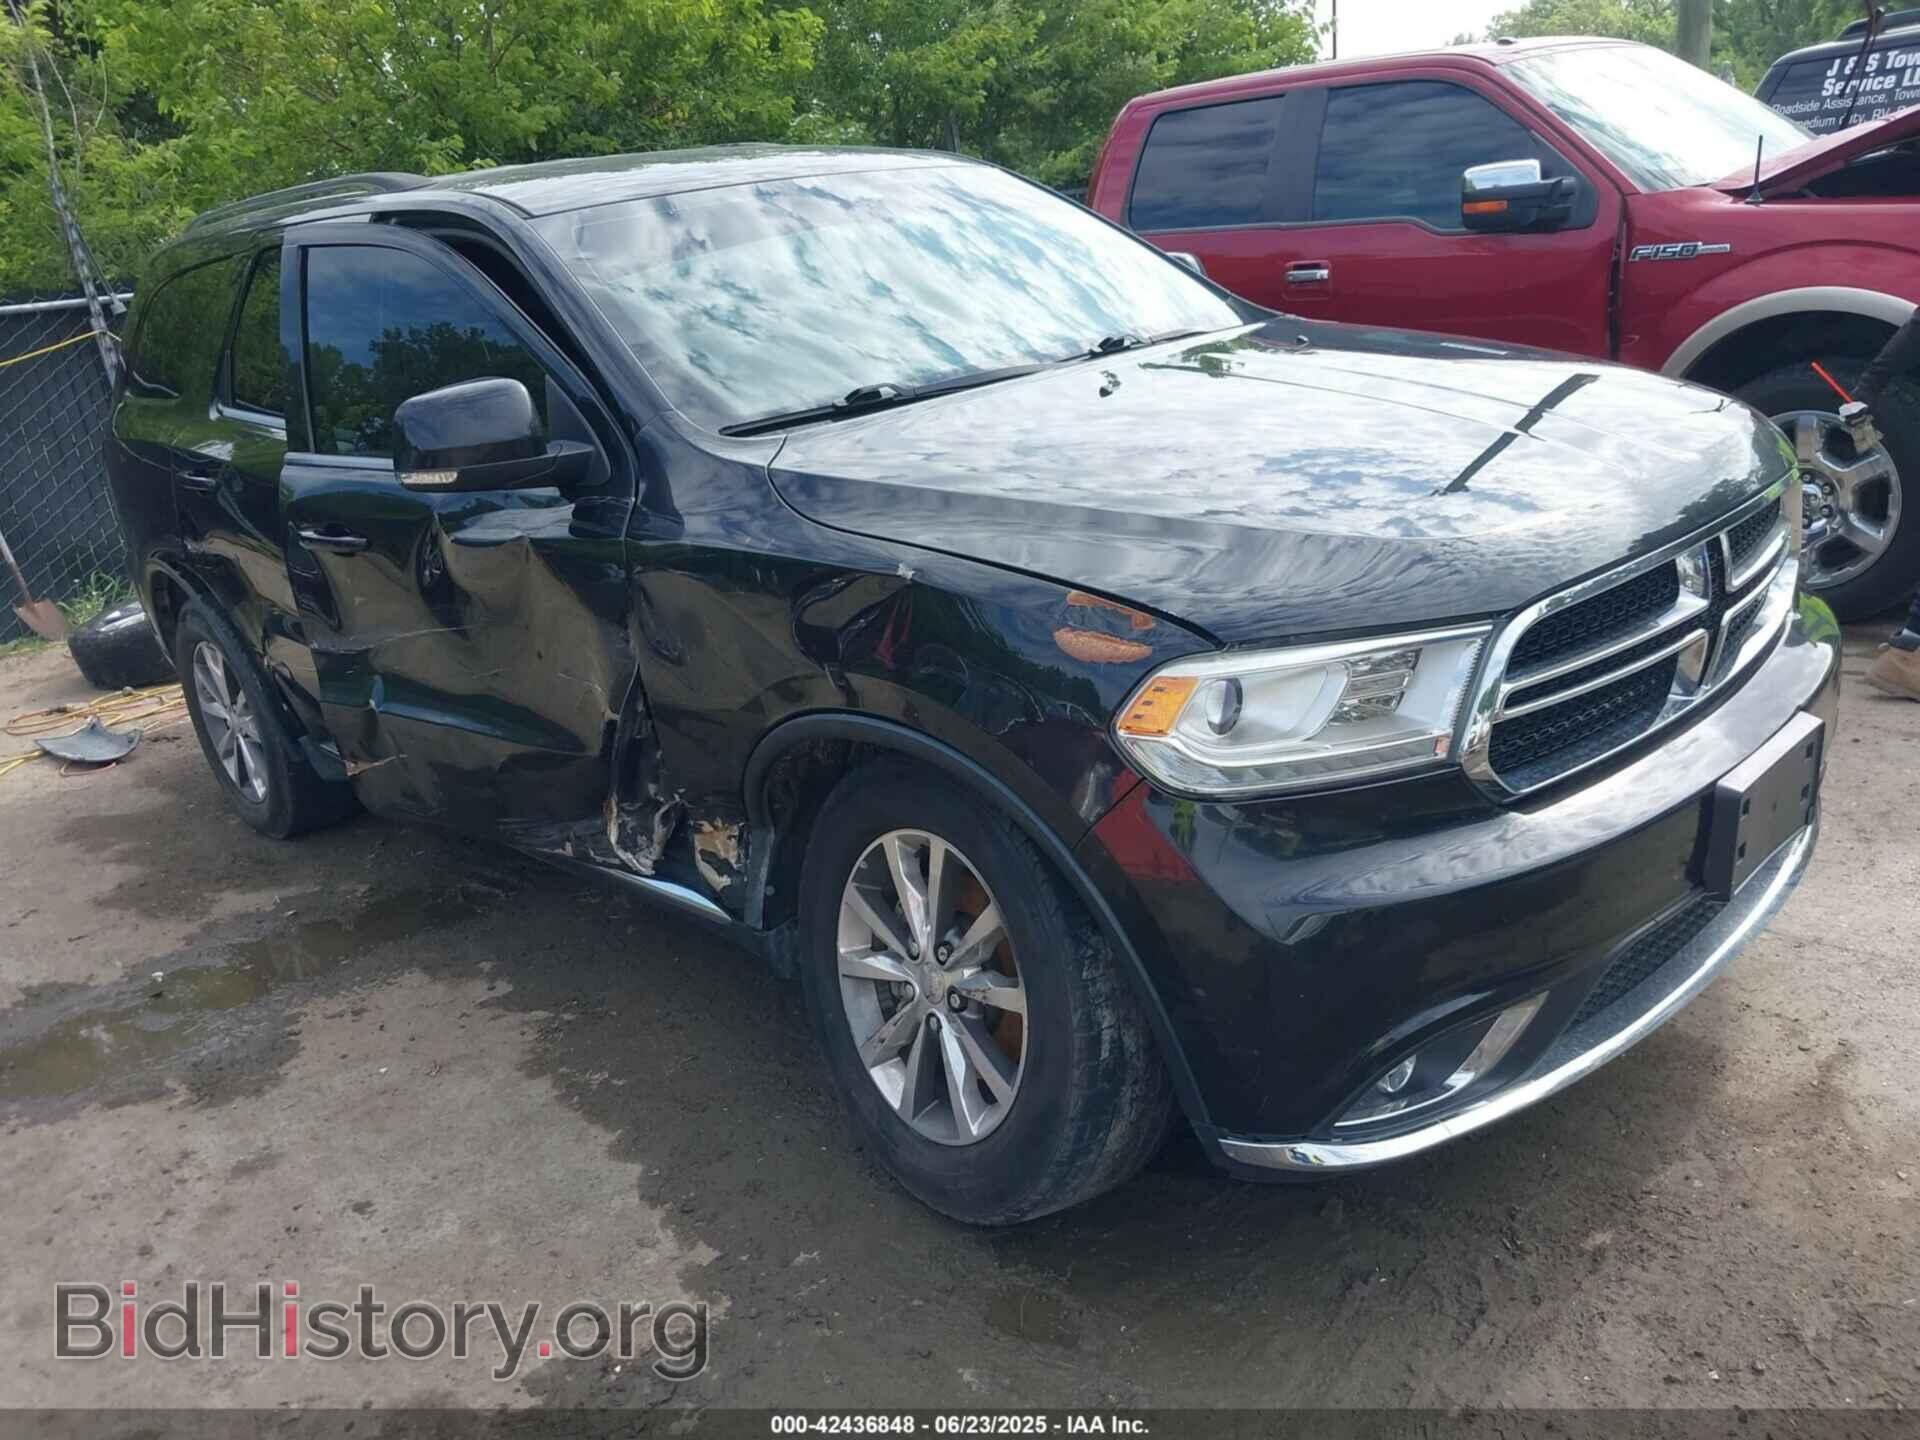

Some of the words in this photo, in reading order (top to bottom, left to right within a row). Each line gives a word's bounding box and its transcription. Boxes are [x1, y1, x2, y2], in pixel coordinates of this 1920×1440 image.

[1826, 58, 1840, 77] J
[1844, 56, 1858, 74] &
[1865, 52, 1880, 72] S
[1821, 72, 1897, 96] Service
